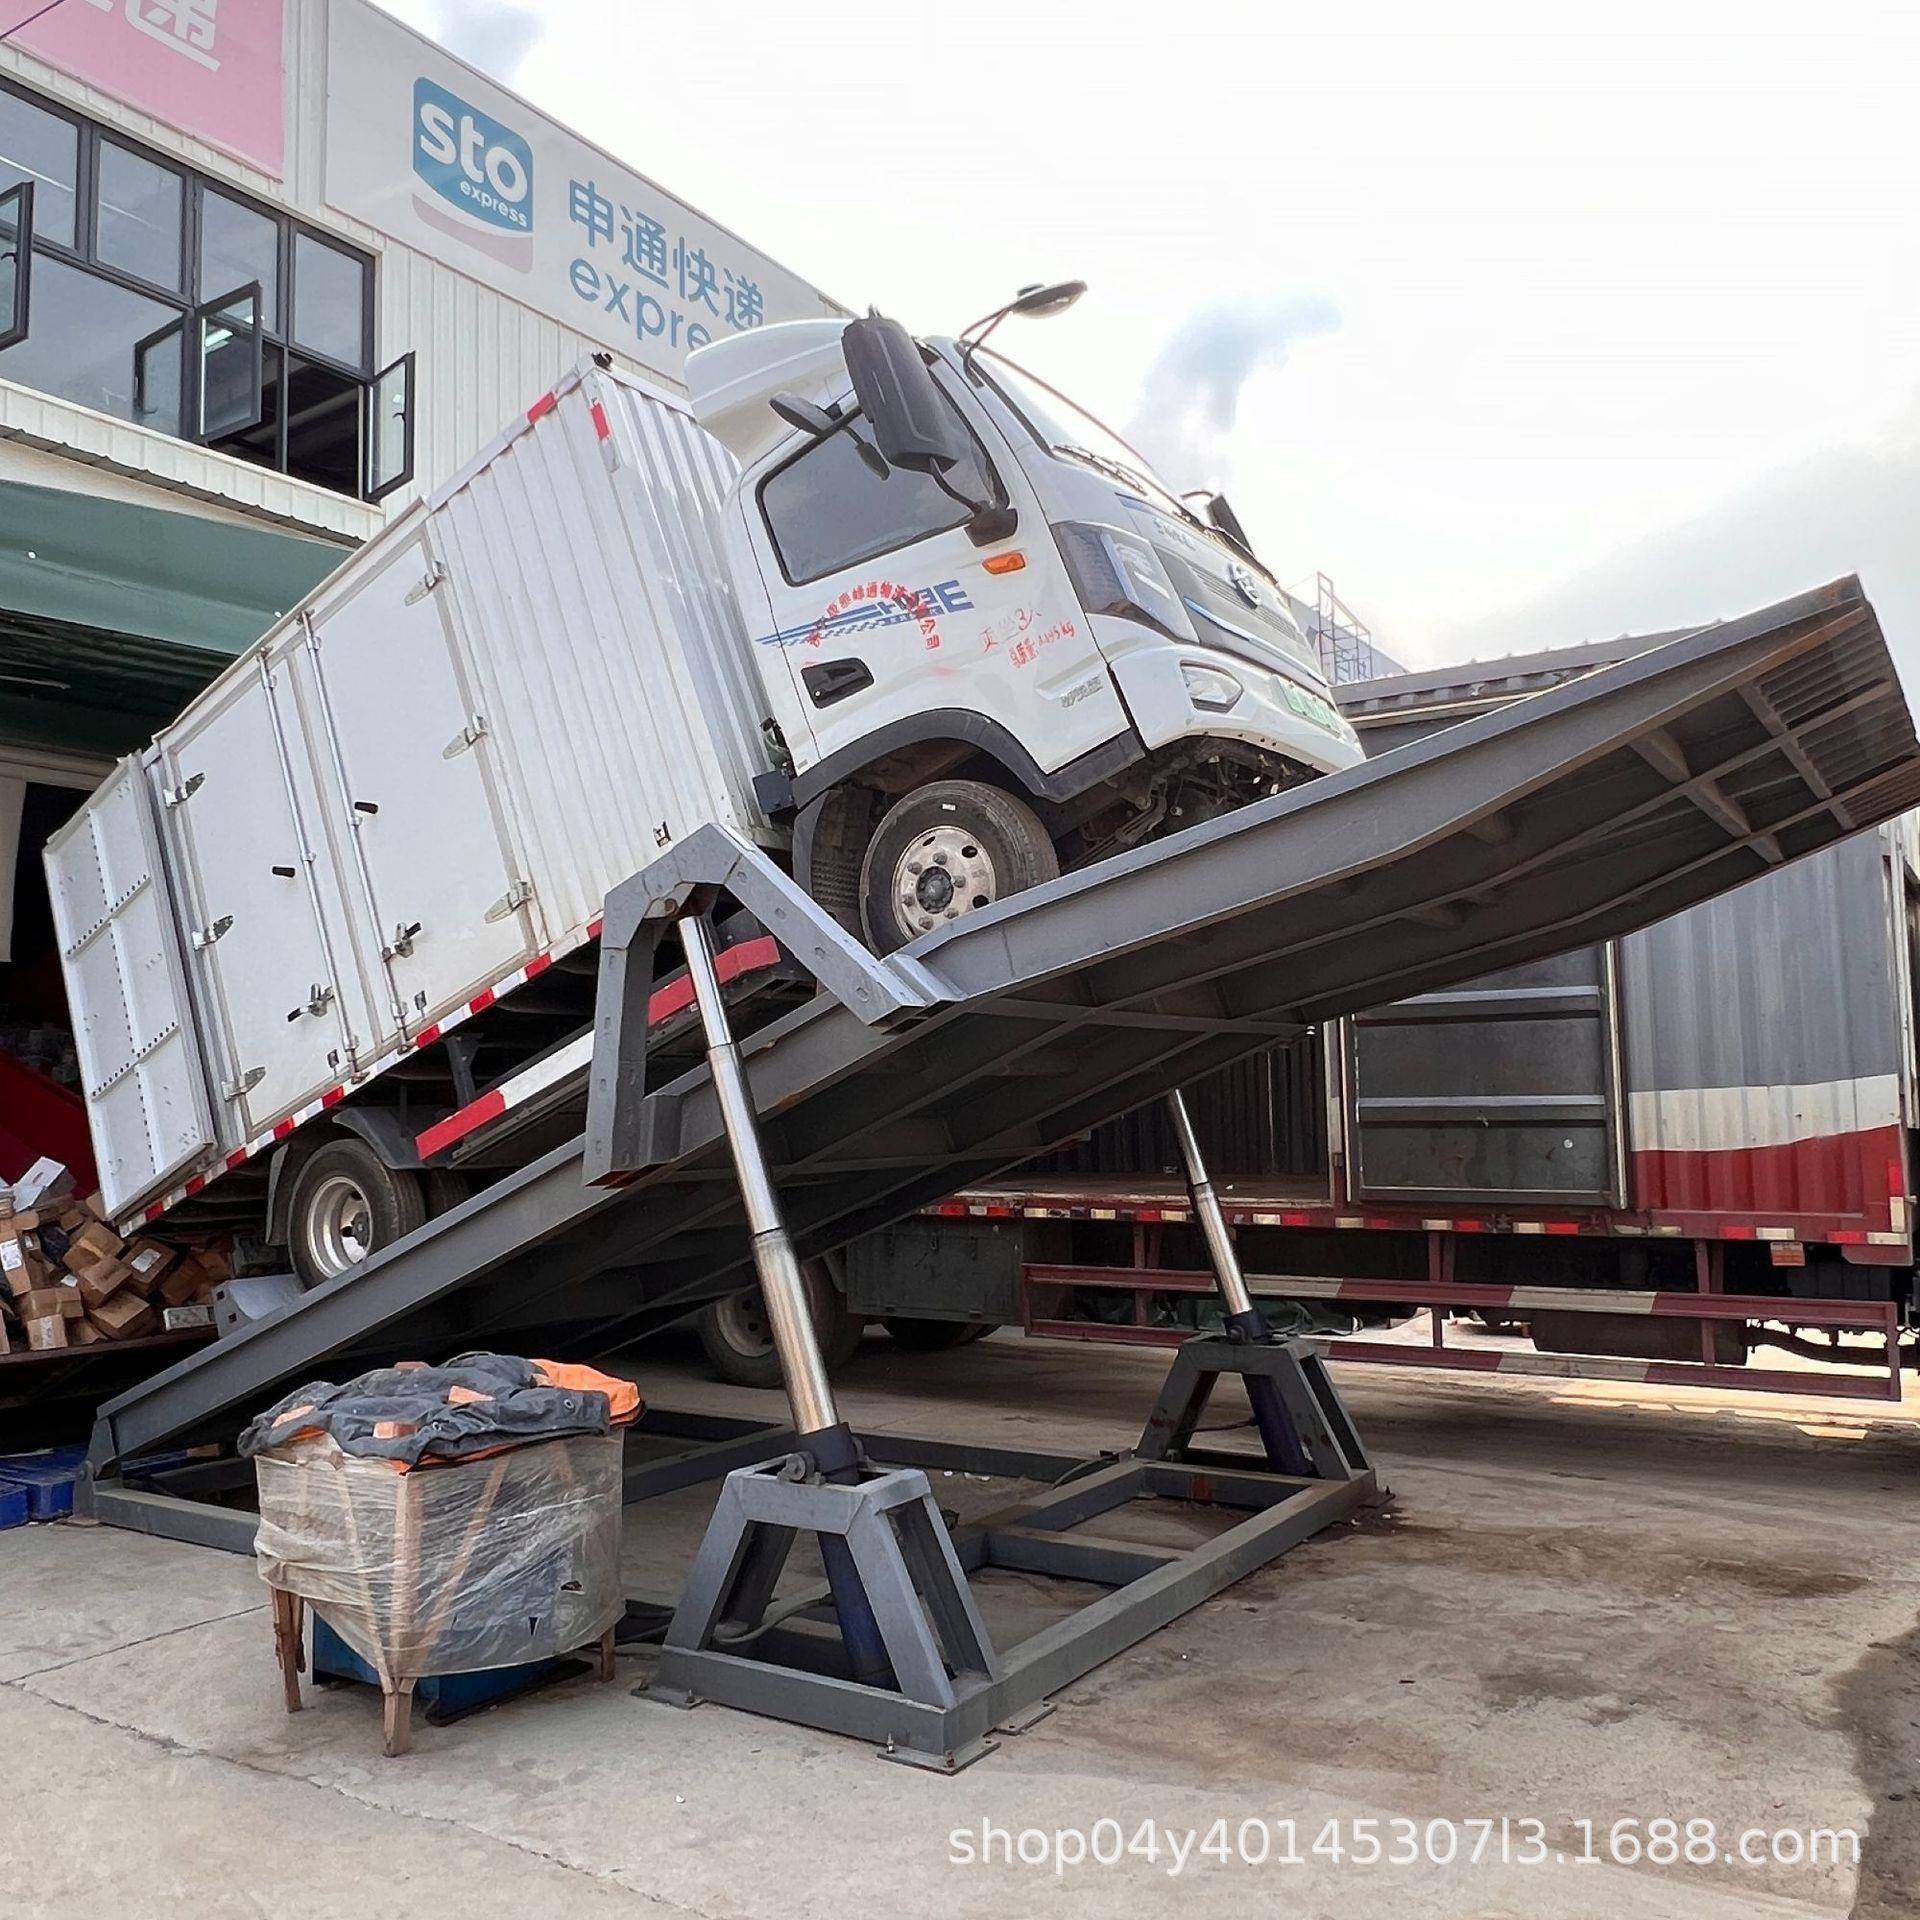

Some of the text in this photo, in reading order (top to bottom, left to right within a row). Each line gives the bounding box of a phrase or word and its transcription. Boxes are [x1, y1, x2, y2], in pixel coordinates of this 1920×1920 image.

[420, 102, 528, 203] sto
[460, 180, 528, 228] express
[569, 178, 764, 331] 申通快递
